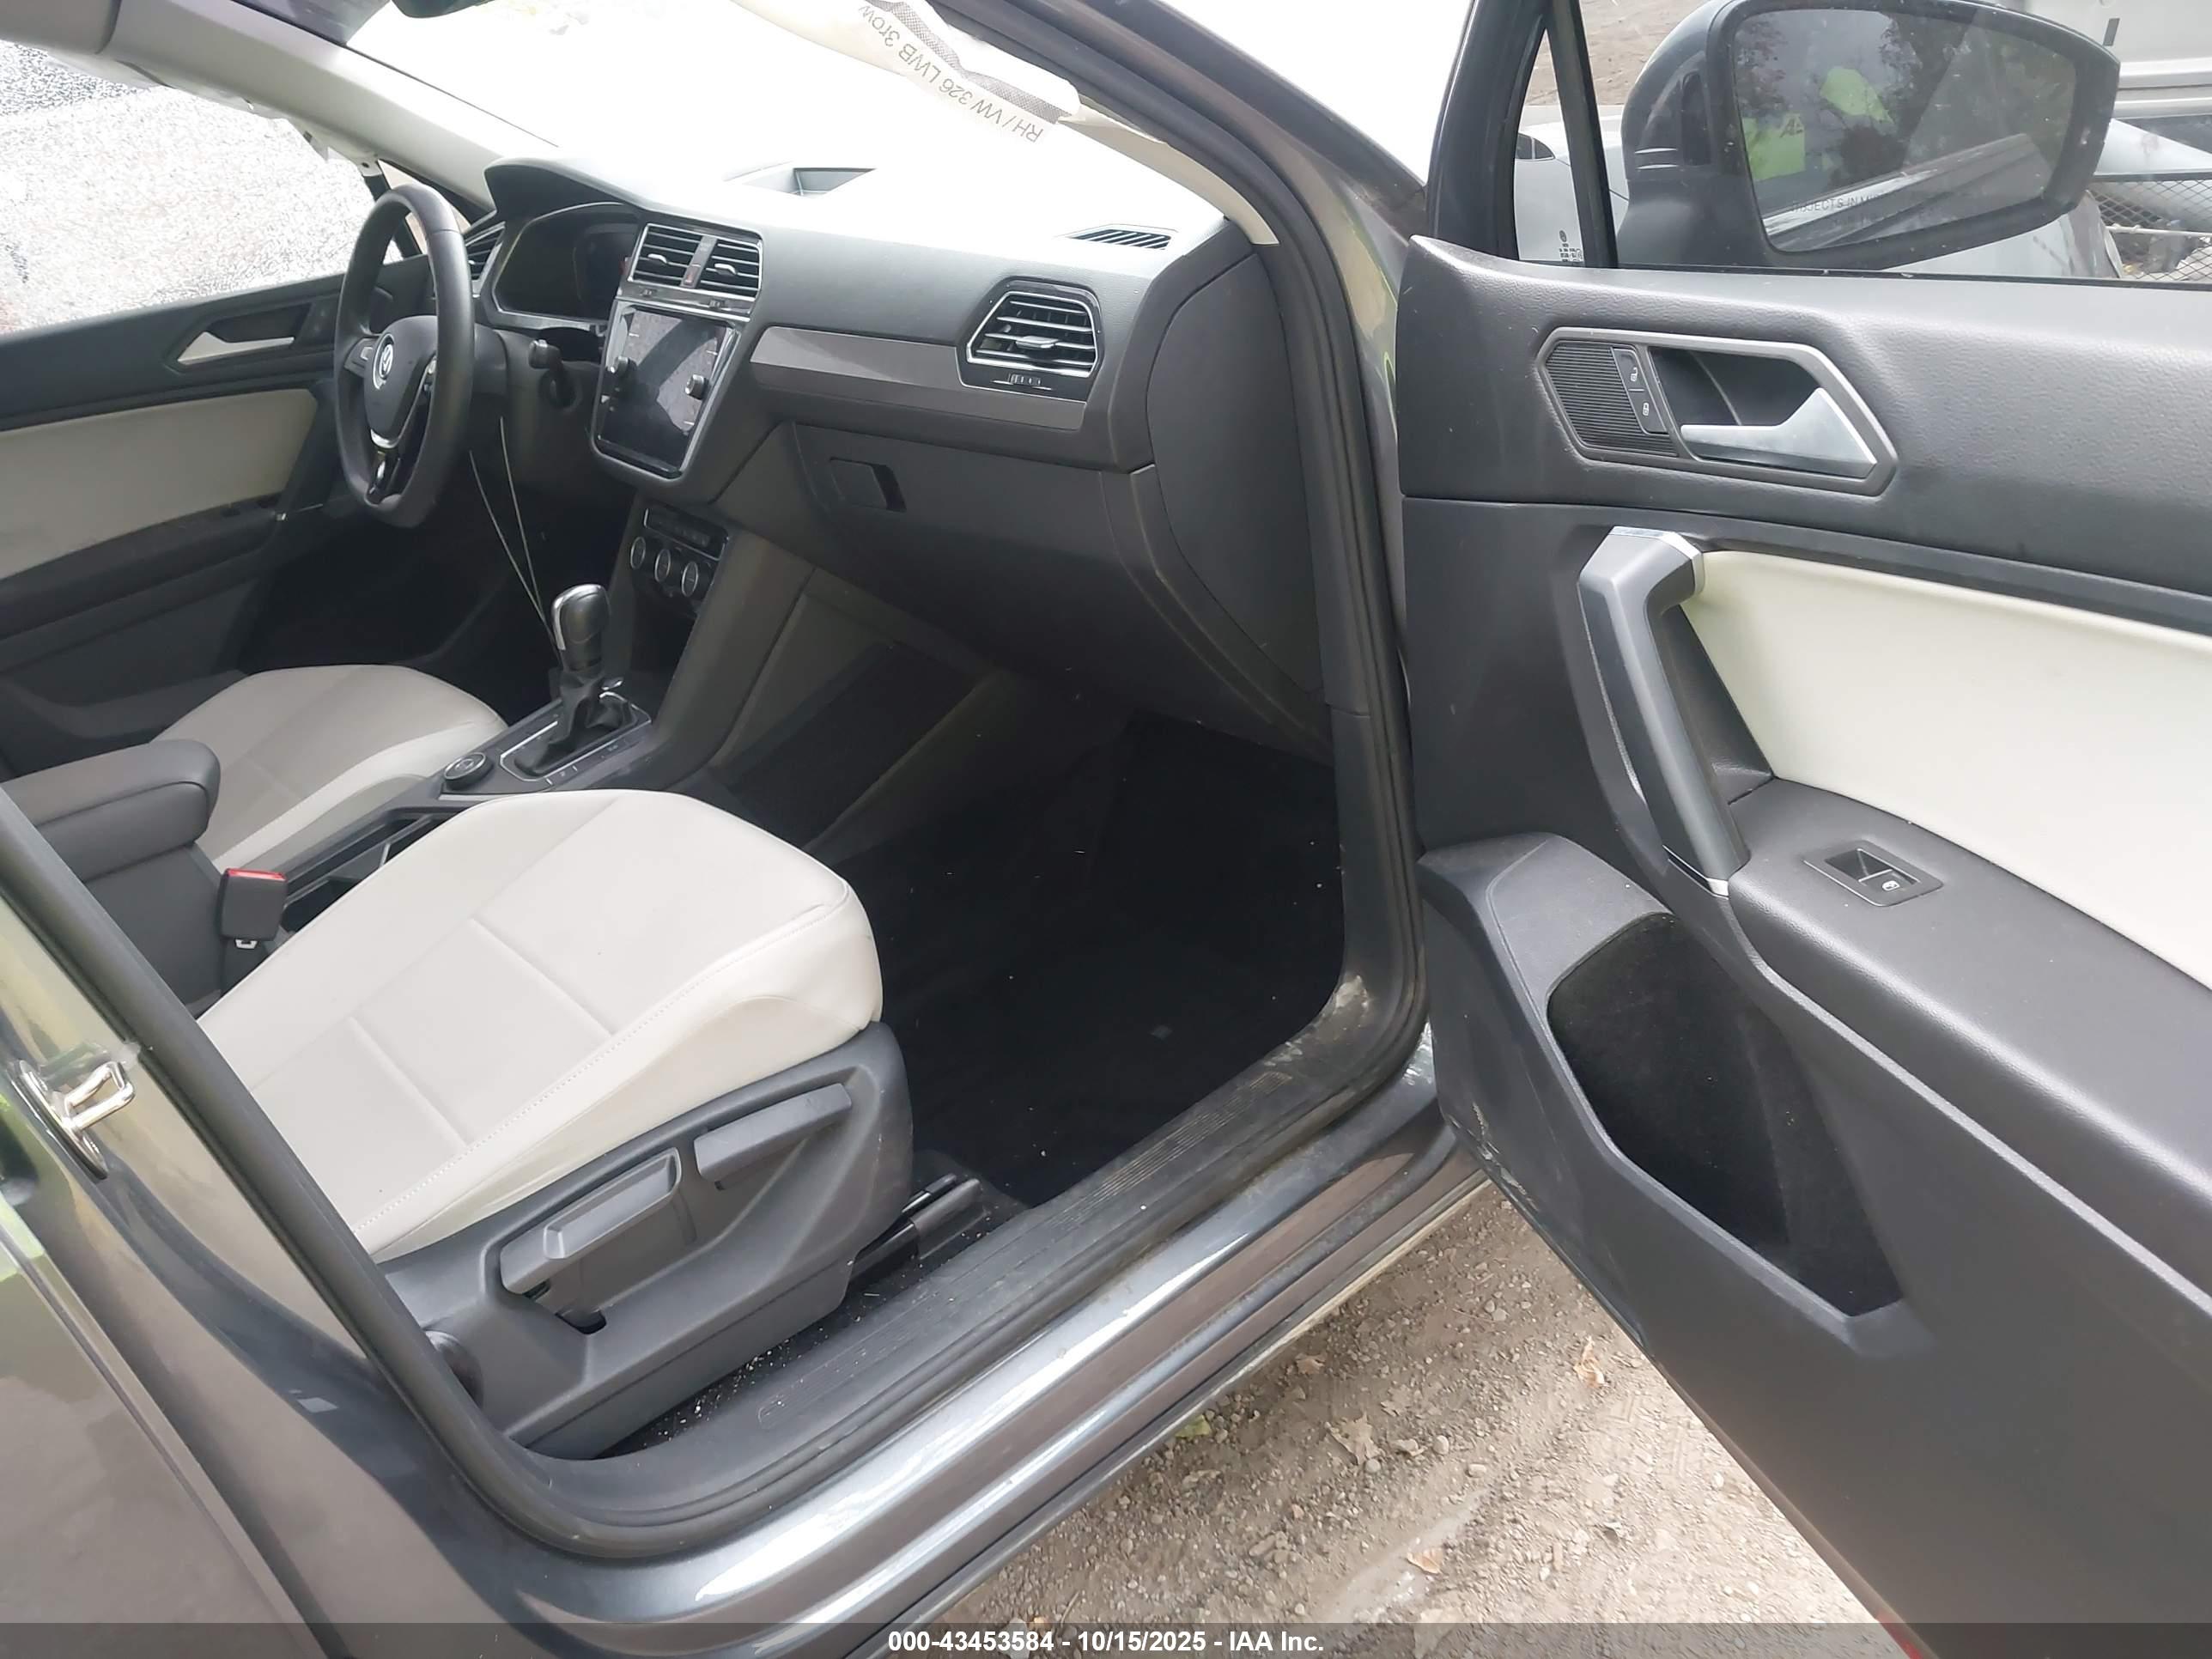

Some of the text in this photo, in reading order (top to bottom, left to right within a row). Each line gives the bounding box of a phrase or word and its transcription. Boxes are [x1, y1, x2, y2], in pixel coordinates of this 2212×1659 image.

[858, 5, 900, 47] 3row
[898, 43, 941, 83] LWB
[939, 78, 973, 105] 326
[969, 99, 1002, 125] VW
[1012, 119, 1044, 143] RH
